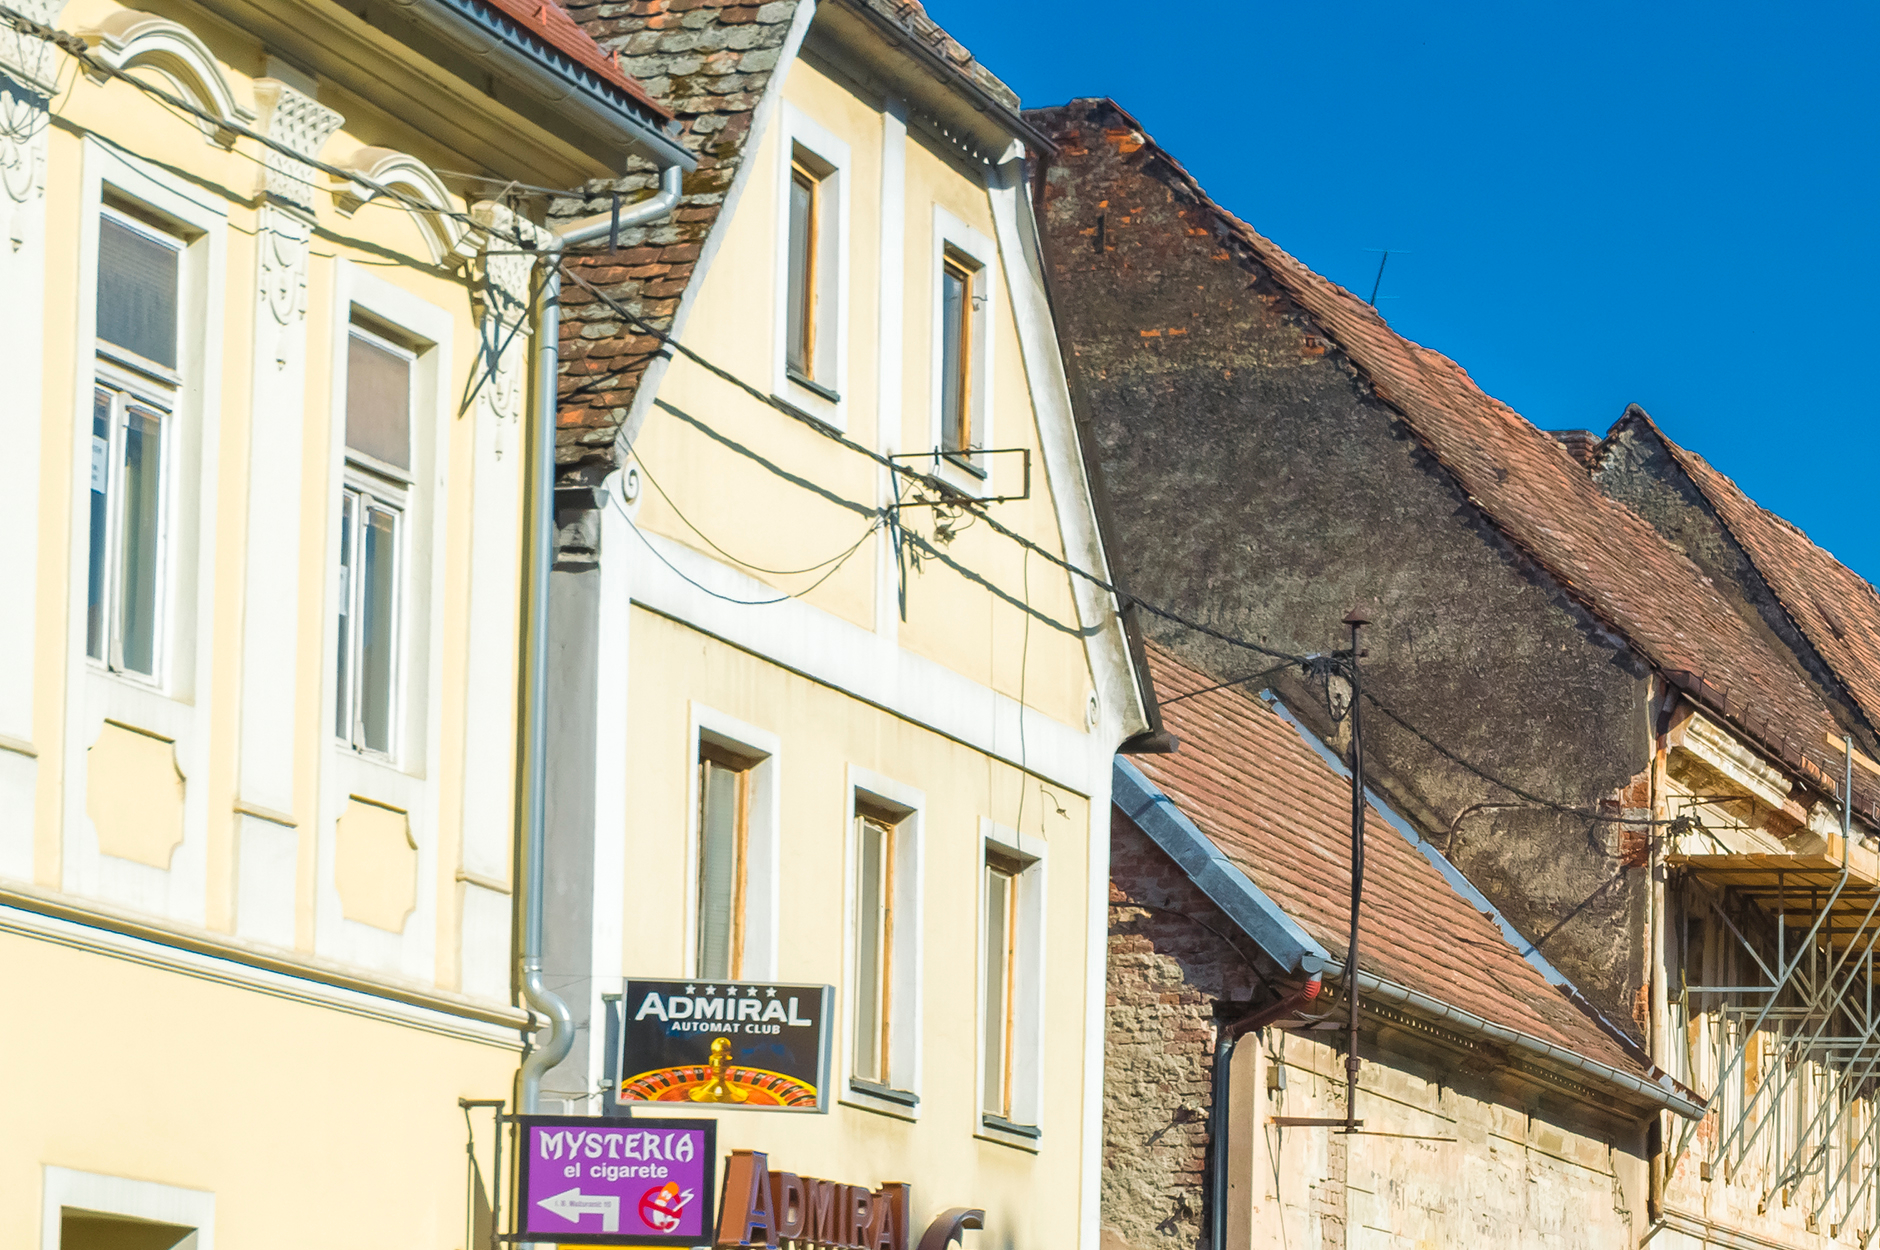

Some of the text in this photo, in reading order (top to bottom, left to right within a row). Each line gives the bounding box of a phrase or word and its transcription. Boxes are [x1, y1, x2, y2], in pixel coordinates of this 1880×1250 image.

[635, 992, 812, 1026] ADMIRAL
[671, 1021, 781, 1034] AUTOMAT CLUB
[539, 1130, 694, 1162] MYSTERIA
[564, 1162, 669, 1182] el cigarete
